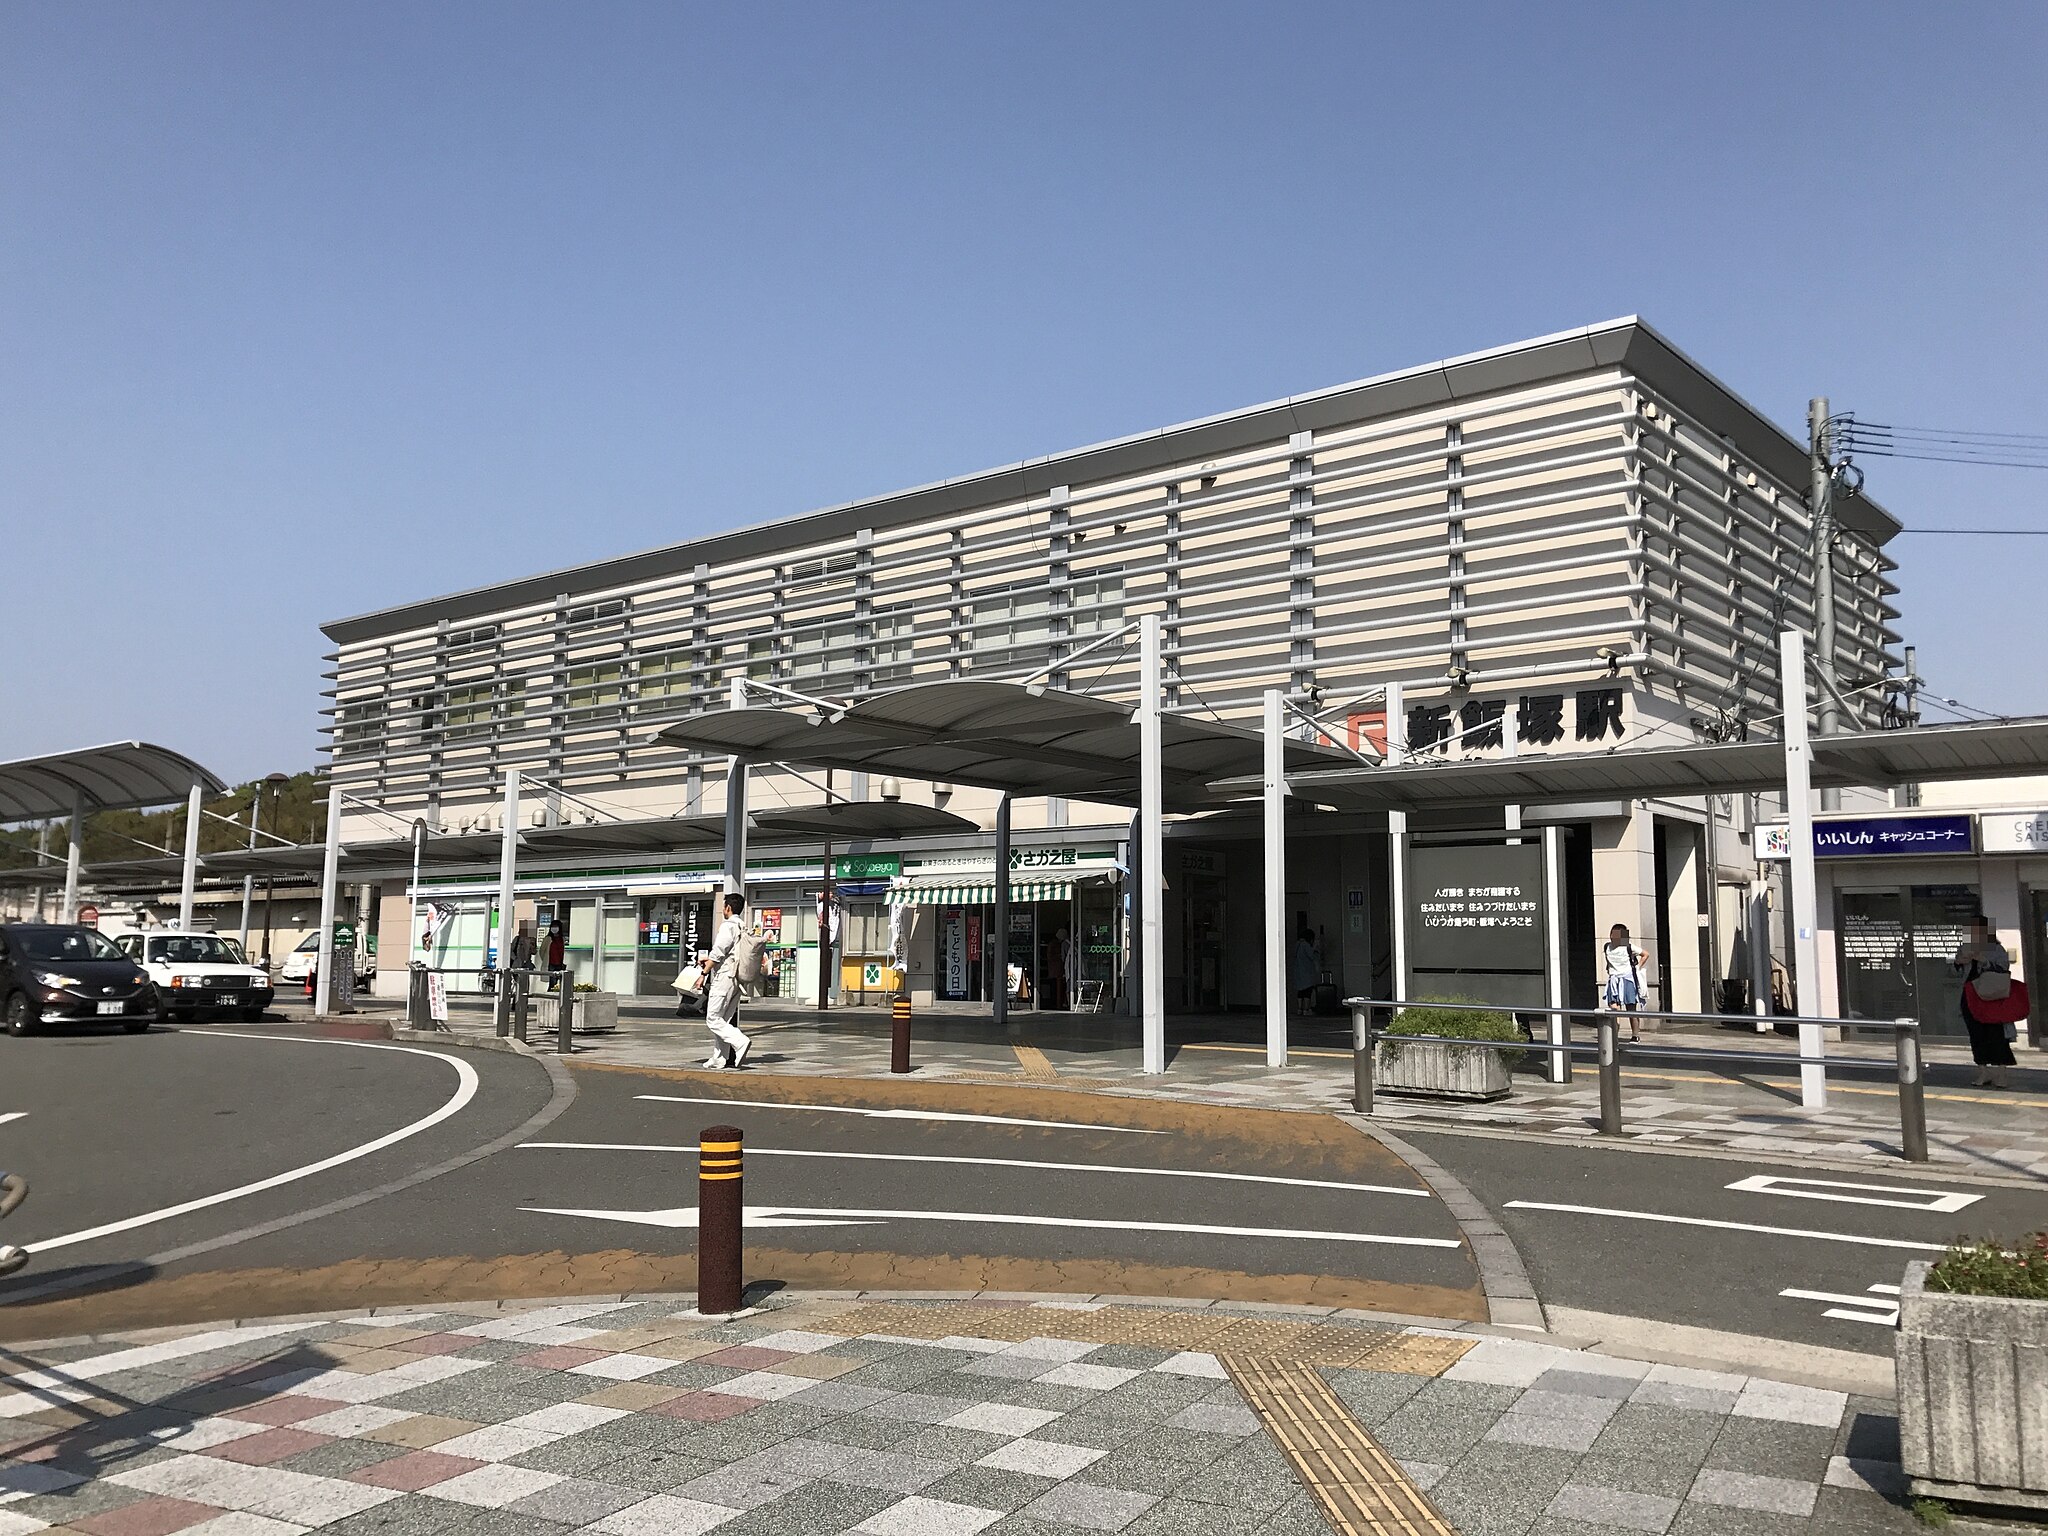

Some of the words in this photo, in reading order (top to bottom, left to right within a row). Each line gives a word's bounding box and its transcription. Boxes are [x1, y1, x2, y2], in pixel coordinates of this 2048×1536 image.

[1407, 688, 1626, 754] 新飯塚駅
[1816, 832, 1873, 844] いいしん
[1879, 830, 1964, 842] キャッシュコーナー
[854, 859, 893, 873] Sakaeya
[674, 872, 706, 881] FamilyMart
[1420, 903, 1464, 912] 住みたいまち
[1468, 901, 1537, 912] 住みつづけたいまち
[970, 926, 978, 954] 母の日
[951, 925, 961, 989] こどもの日
